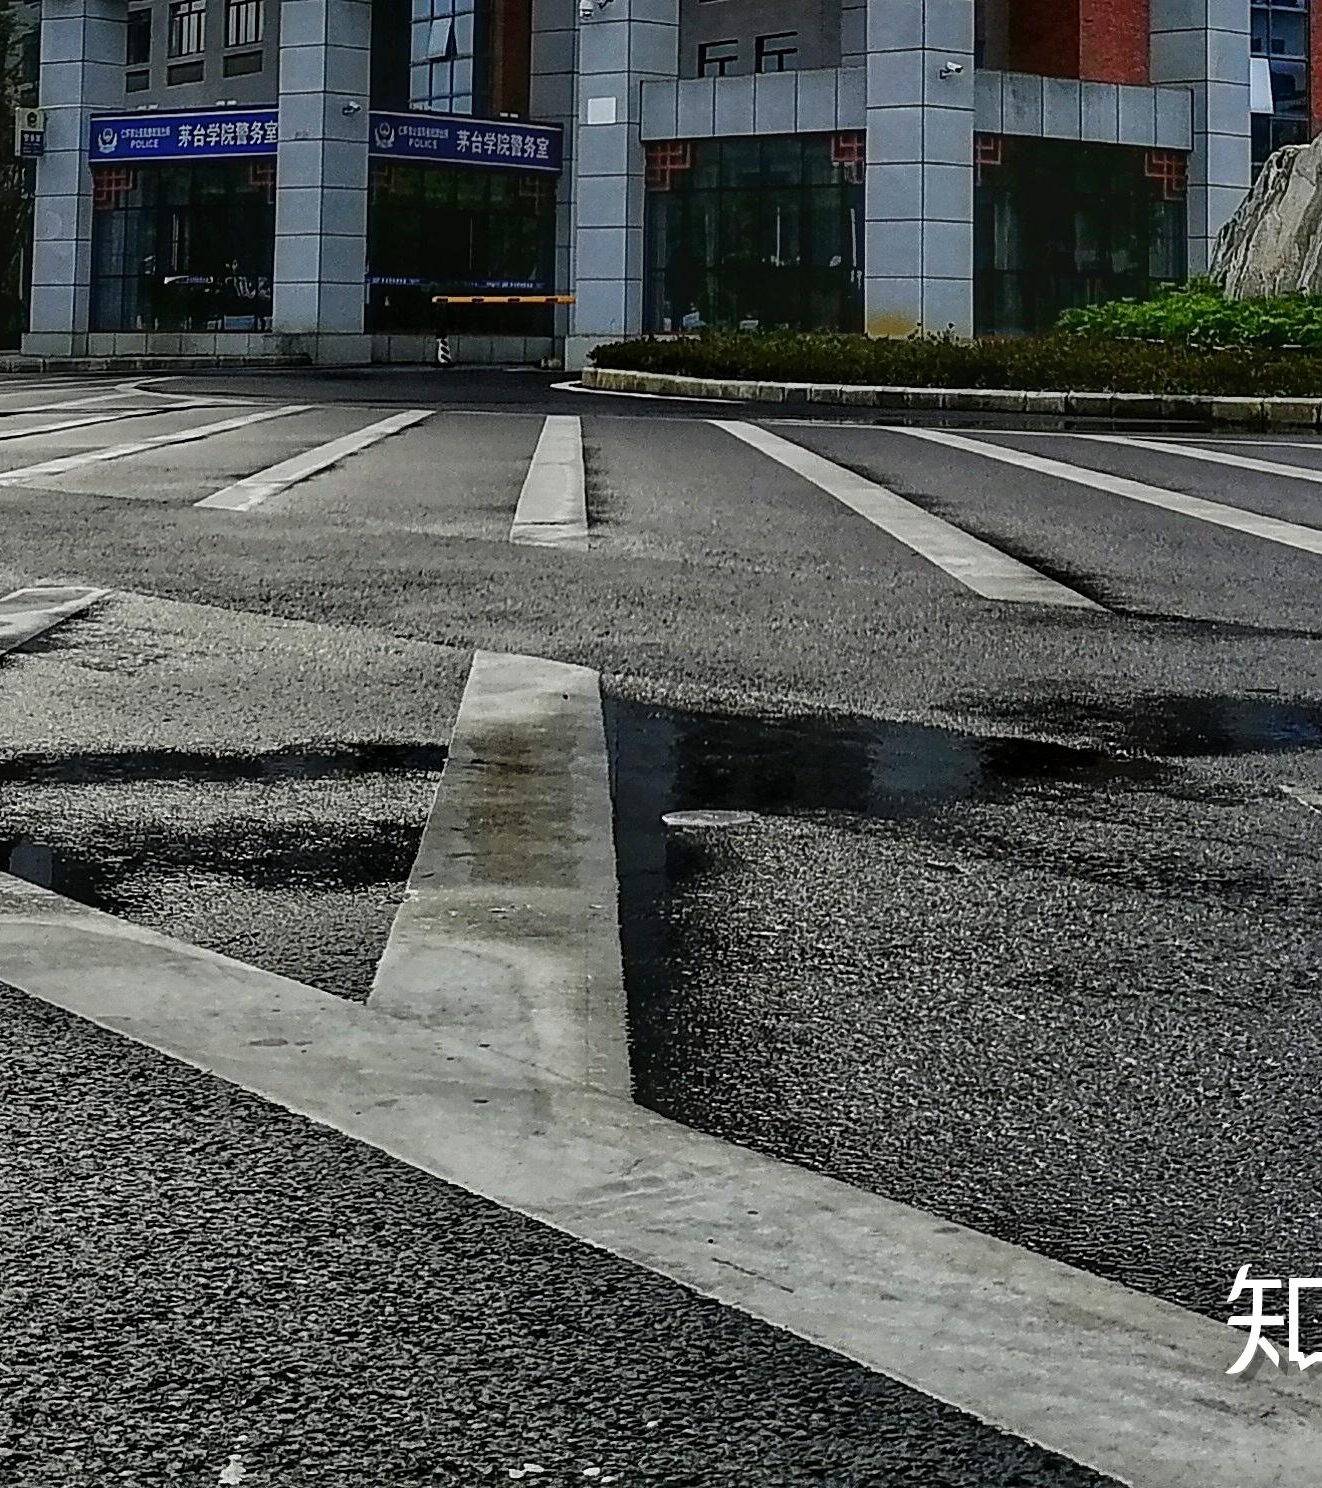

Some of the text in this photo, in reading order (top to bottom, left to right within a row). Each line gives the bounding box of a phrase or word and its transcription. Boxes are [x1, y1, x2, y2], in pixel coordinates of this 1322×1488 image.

[130, 138, 159, 149] POLICE
[178, 120, 277, 148] 茅台学院警务室
[408, 139, 438, 150] POLICE
[457, 129, 549, 159] 茅台学院警务室
